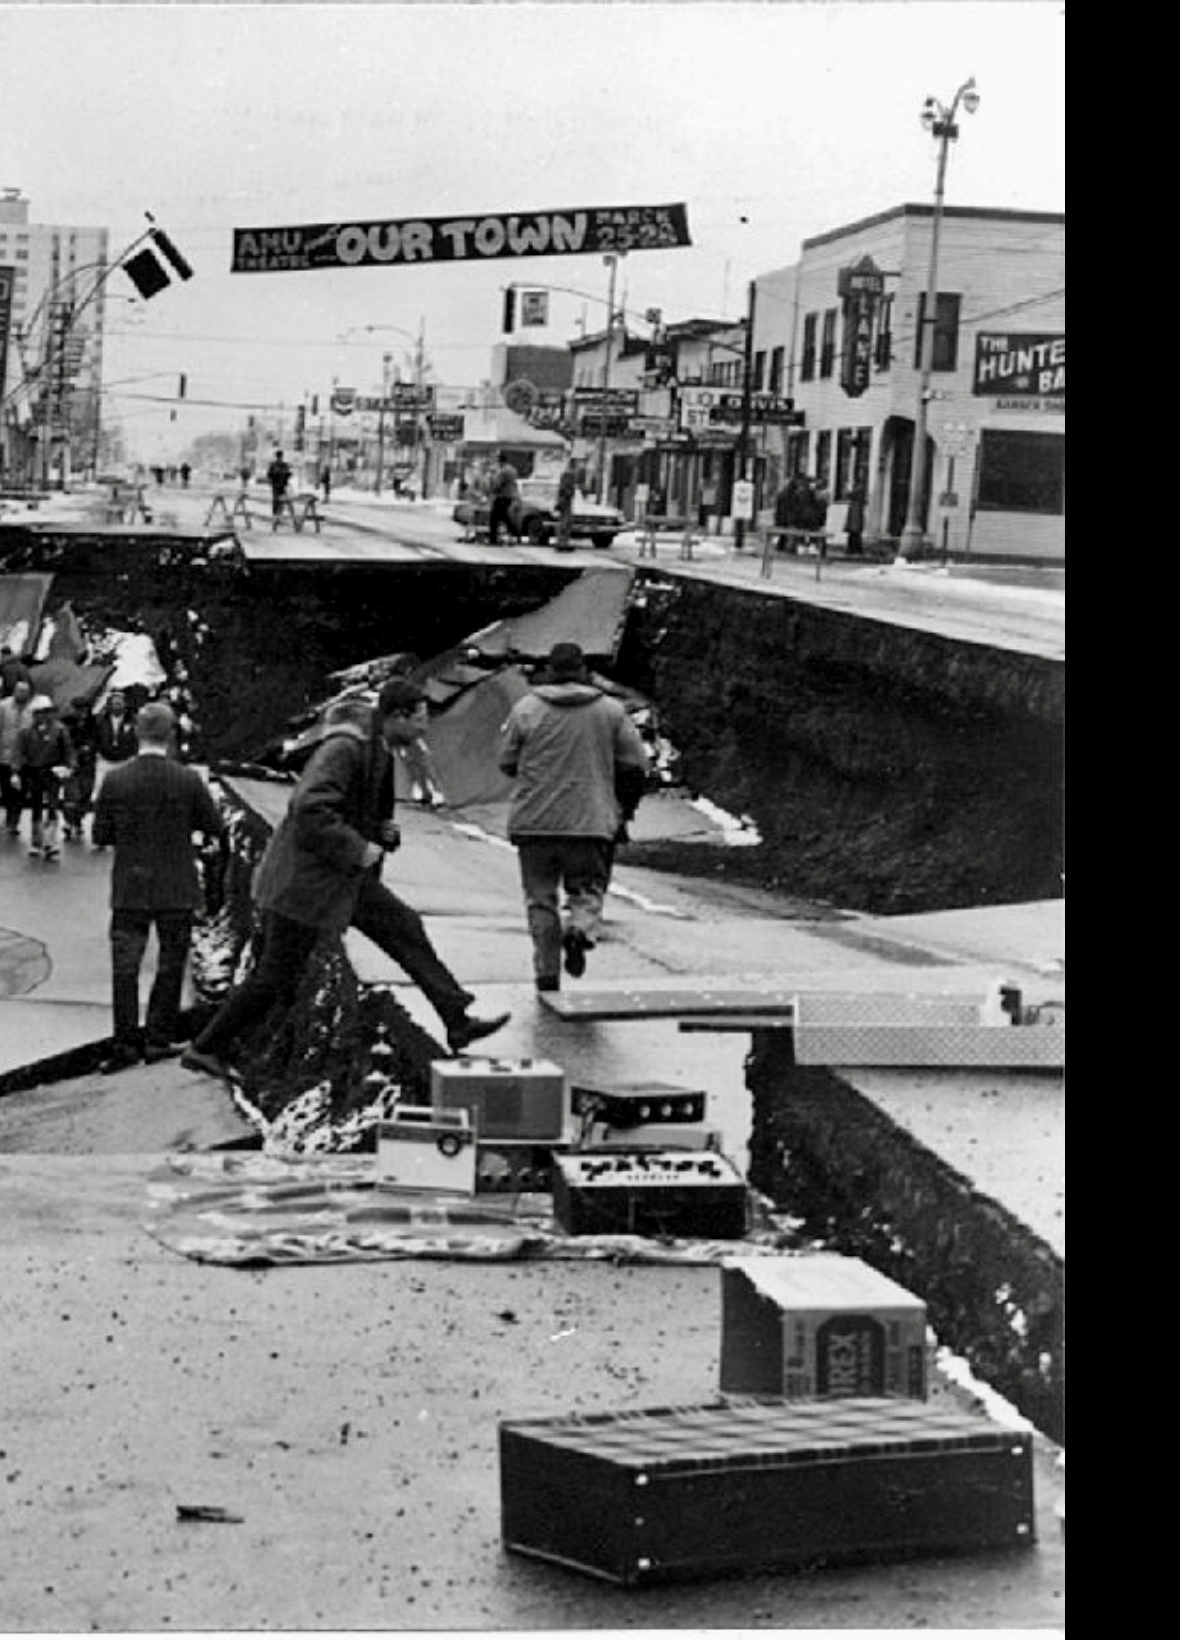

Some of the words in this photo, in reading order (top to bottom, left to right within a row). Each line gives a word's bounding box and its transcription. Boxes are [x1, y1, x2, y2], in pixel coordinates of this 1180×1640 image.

[335, 221, 434, 264] OUR
[438, 211, 588, 258] TOWN
[978, 339, 1065, 383] HUNTE
[828, 1330, 857, 1394] REX
